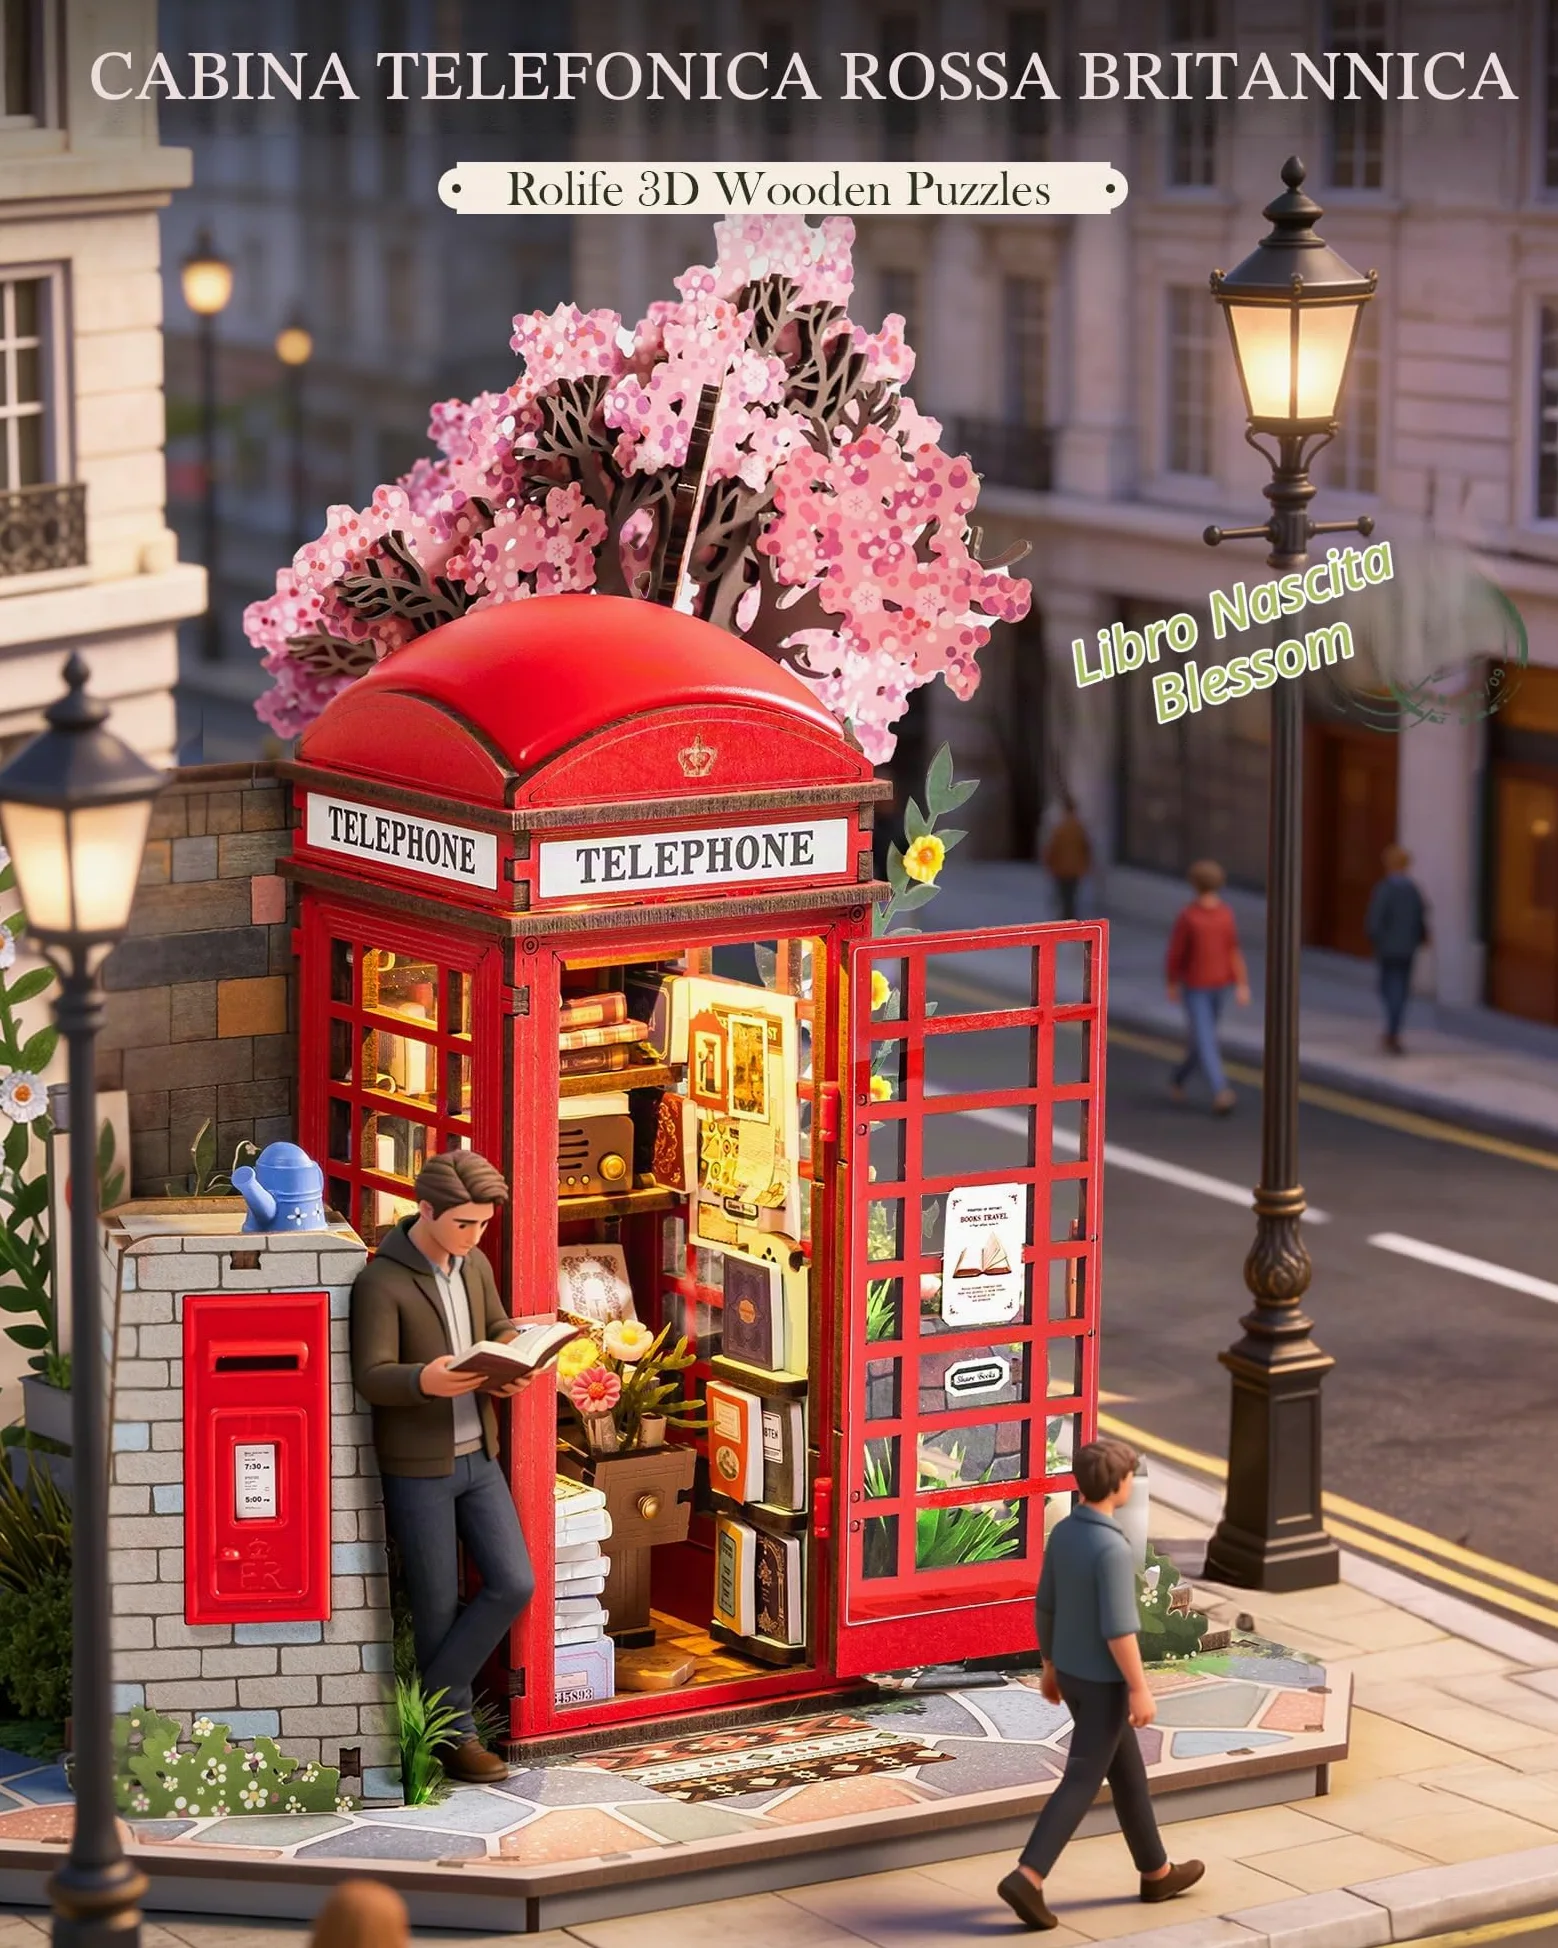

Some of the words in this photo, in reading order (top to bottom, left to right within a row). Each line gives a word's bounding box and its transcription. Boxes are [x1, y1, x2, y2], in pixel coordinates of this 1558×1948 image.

[328, 805, 477, 875] TELEPHONE
[576, 830, 815, 884] TELEPHONE
[960, 1214, 982, 1224] BOOKS
[983, 1212, 1009, 1222] TRAVEL
